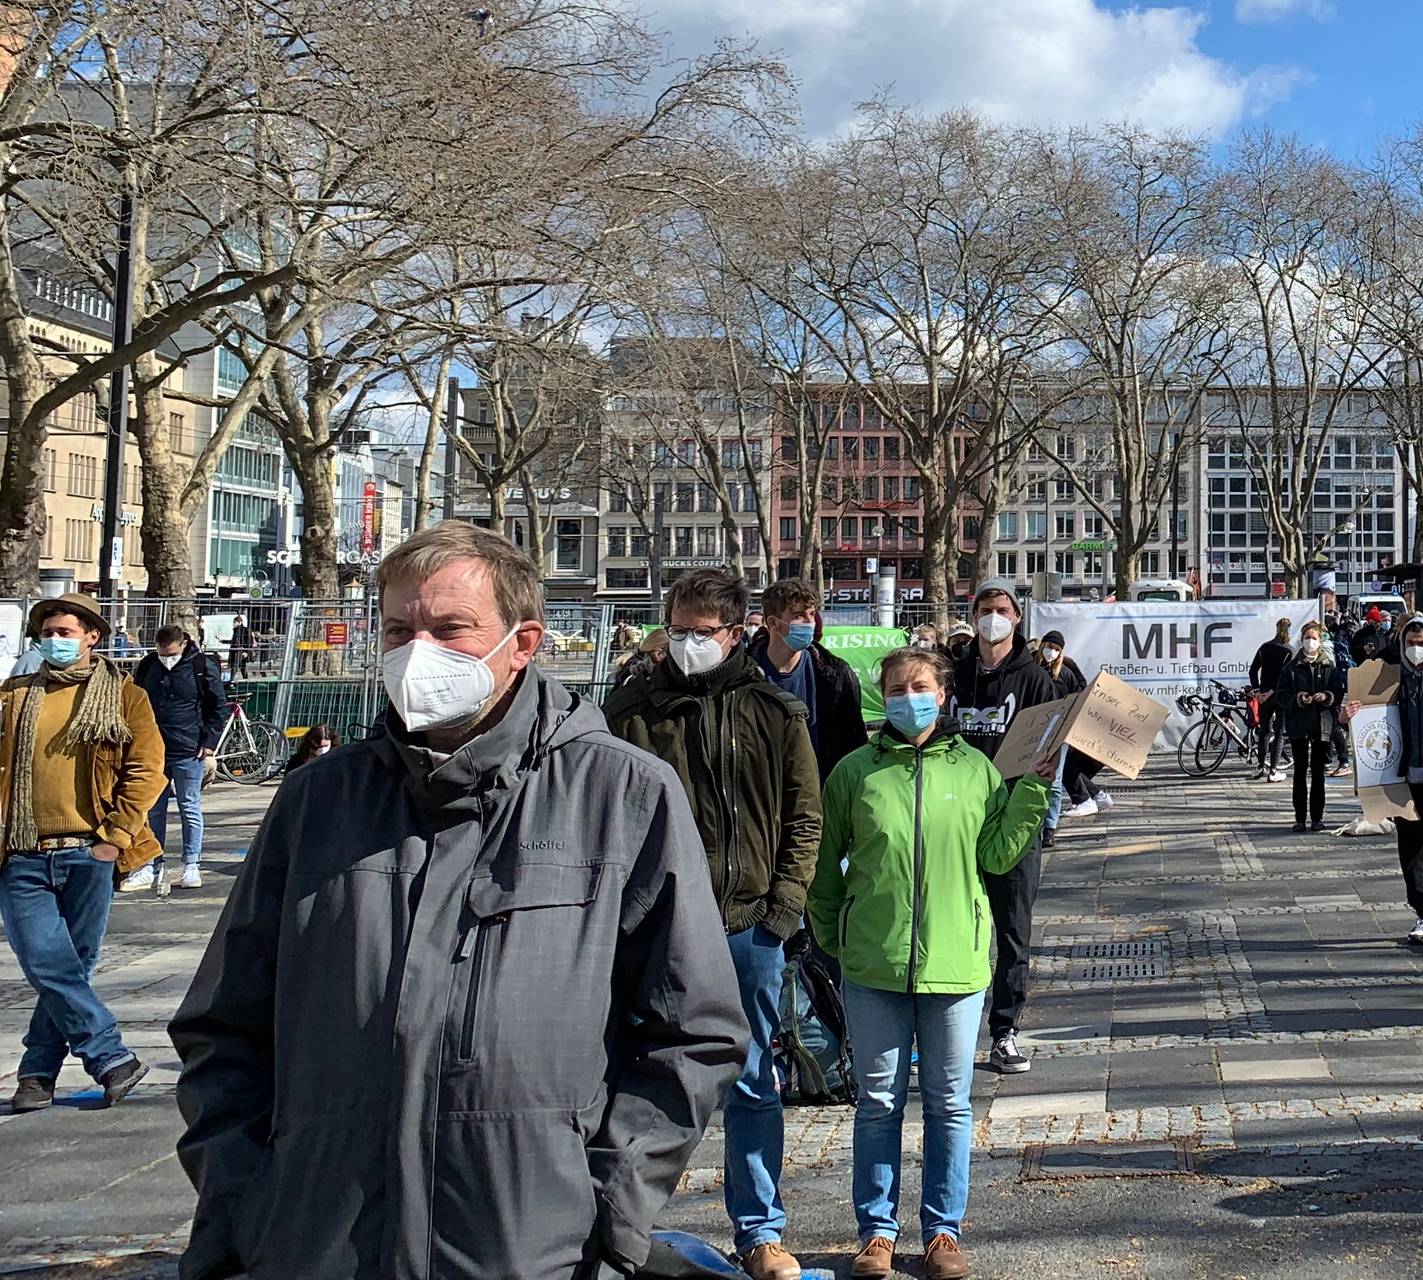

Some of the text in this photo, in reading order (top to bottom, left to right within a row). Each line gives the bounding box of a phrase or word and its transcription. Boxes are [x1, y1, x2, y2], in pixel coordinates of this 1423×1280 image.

[1121, 621, 1233, 660] MHF
[1156, 666, 1167, 675] u.
[1172, 662, 1215, 675] Tiefbau
